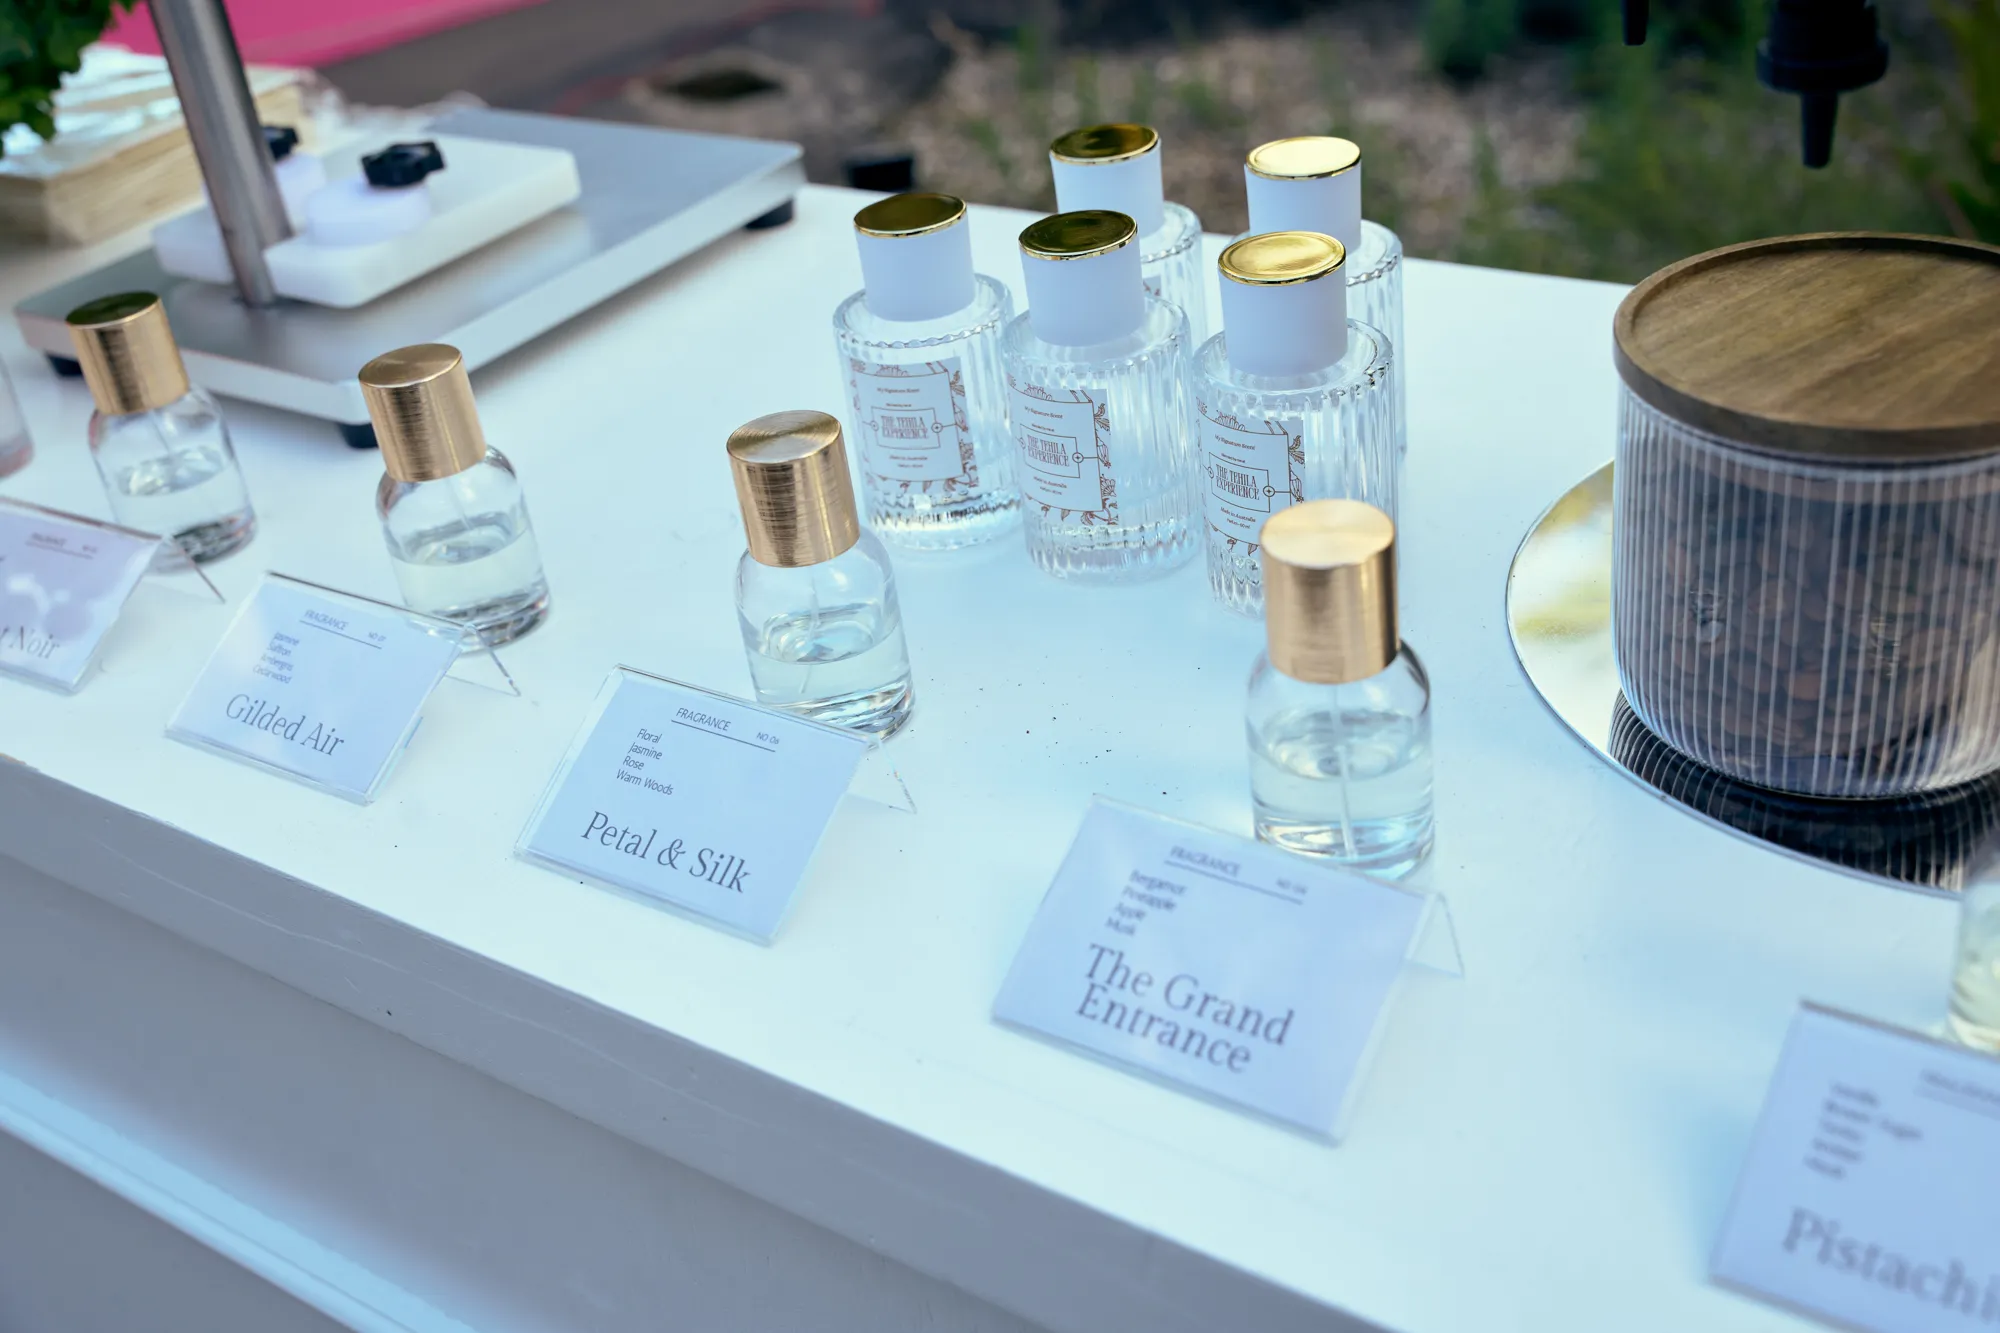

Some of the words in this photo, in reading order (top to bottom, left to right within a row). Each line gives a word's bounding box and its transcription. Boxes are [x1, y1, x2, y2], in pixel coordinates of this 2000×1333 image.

[881, 415, 894, 430] THE
[896, 415, 927, 430] TEHILA
[882, 427, 929, 440] EXPERIENCE
[1027, 434, 1039, 451] THE
[1040, 438, 1067, 455] TEHILA
[1027, 448, 1070, 467] EXPERIENCE
[1216, 463, 1229, 481] THE
[1229, 469, 1257, 488] TEHILA
[1216, 476, 1260, 501] EXPERIENCE
[1236, 513, 1256, 523] Australia
[303, 609, 349, 631] FRAGRANCE
[8, 625, 61, 659] Noir
[226, 693, 306, 741] Gilded
[300, 722, 345, 756] Air
[637, 728, 662, 744] Floral
[675, 707, 731, 732] FRAGRANCE
[756, 731, 769, 742] NO
[622, 755, 645, 771] Rose
[628, 742, 663, 760] Jasmine
[616, 769, 642, 786] Warm
[643, 777, 674, 796] Woods
[580, 810, 657, 860] Petal
[657, 838, 686, 870] &
[689, 847, 752, 894] Silk
[1169, 845, 1241, 877] FRAGRANCE
[1085, 942, 1154, 998] The
[1164, 973, 1295, 1046] Grand
[1076, 982, 1251, 1074] Entrance
